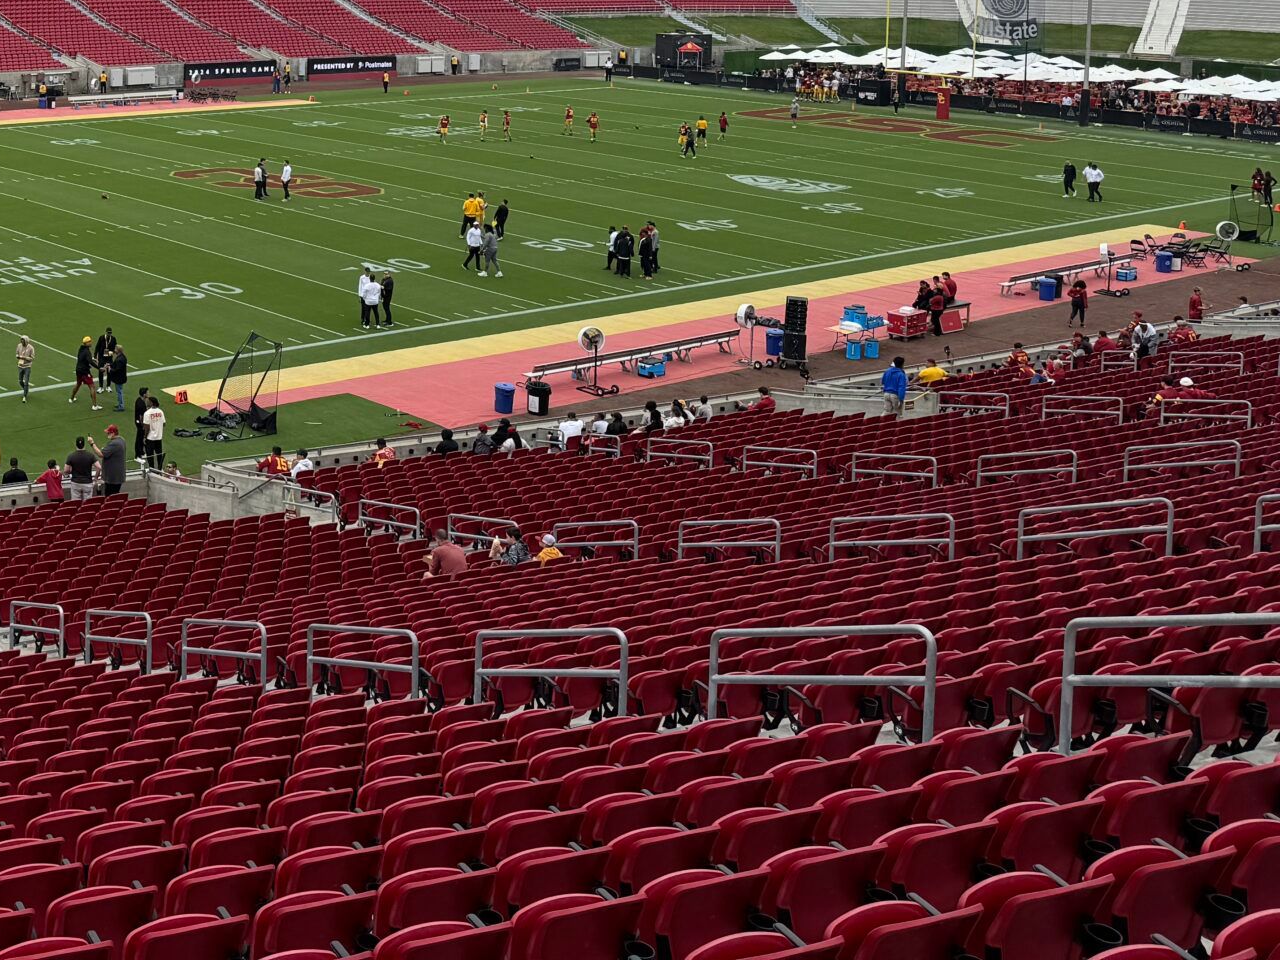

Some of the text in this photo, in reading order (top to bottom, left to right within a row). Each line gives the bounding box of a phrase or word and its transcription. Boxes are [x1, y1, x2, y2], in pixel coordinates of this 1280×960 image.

[974, 21, 1038, 39] llstate
[215, 67, 247, 75] SPRING
[313, 62, 345, 70] PRESENTED
[676, 219, 738, 232] 40
[522, 237, 595, 252] 50
[360, 258, 431, 273] 40
[160, 282, 244, 300] 30
[178, 391, 188, 402] 20
[276, 457, 288, 471] 15
